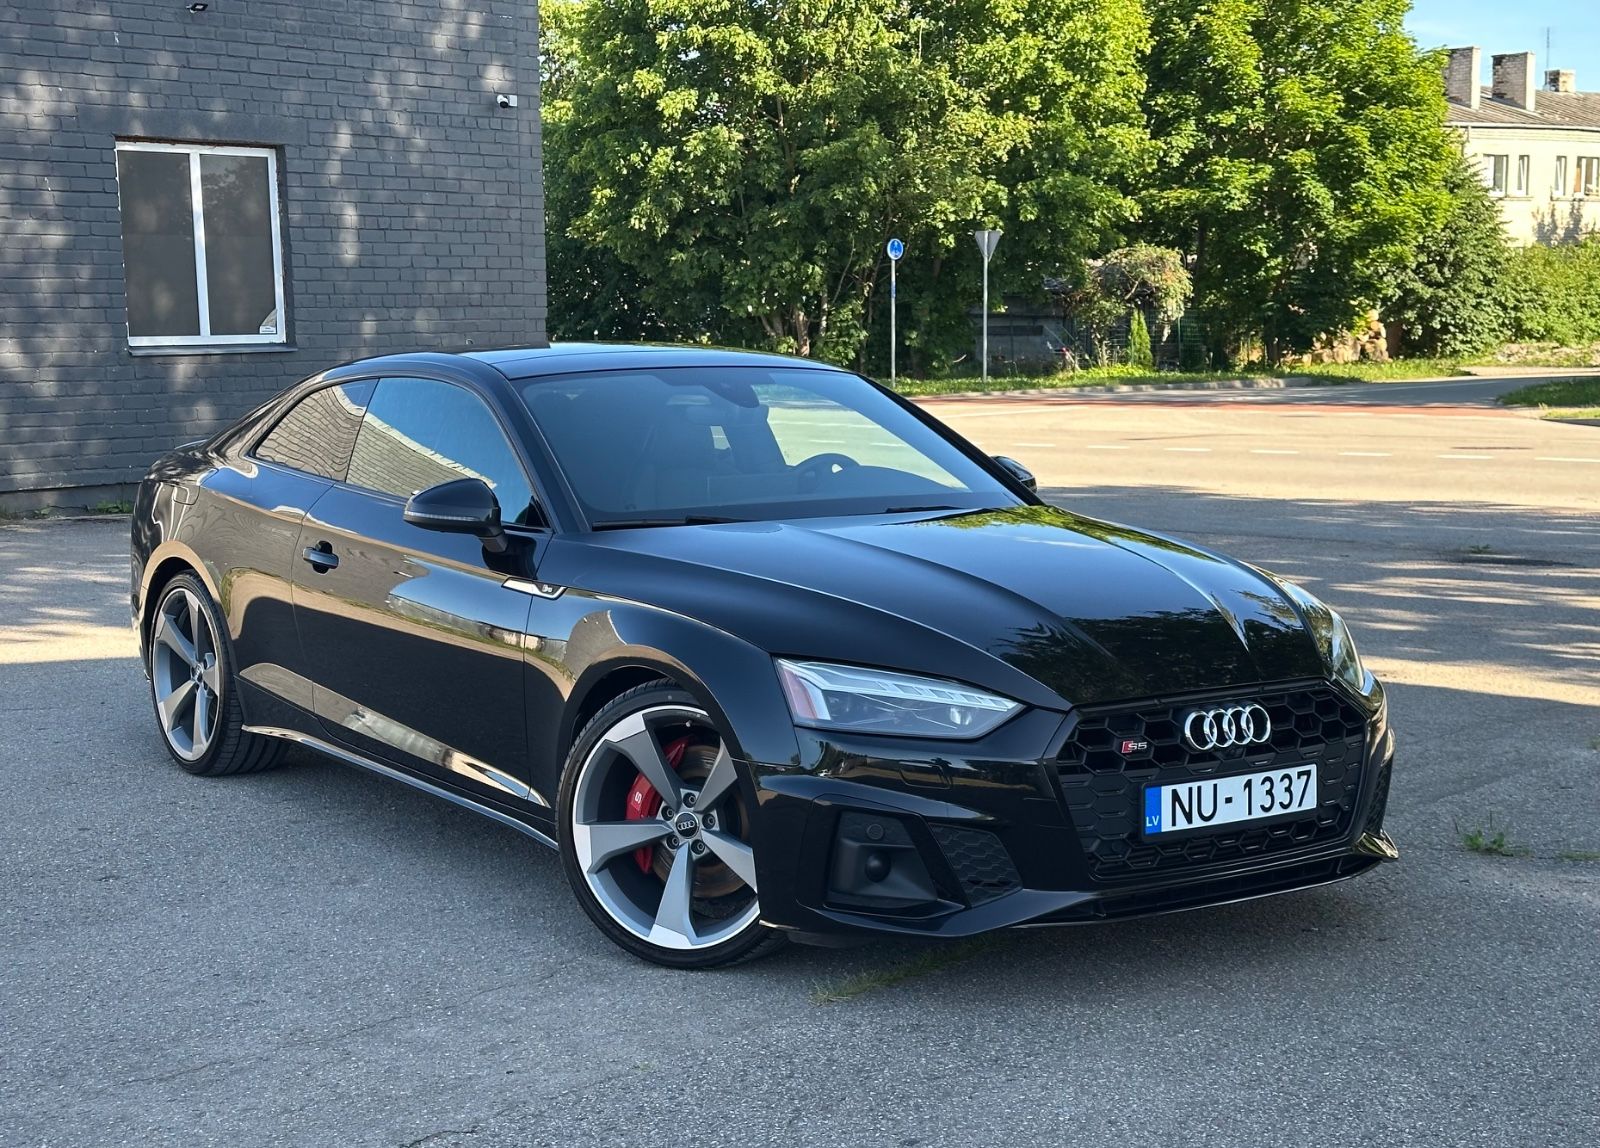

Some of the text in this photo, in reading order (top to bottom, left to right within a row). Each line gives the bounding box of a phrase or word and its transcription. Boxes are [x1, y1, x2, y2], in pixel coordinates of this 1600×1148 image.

[1126, 741, 1148, 751] S5
[1171, 769, 1312, 827] NU-1337
[1145, 815, 1160, 827] LV
